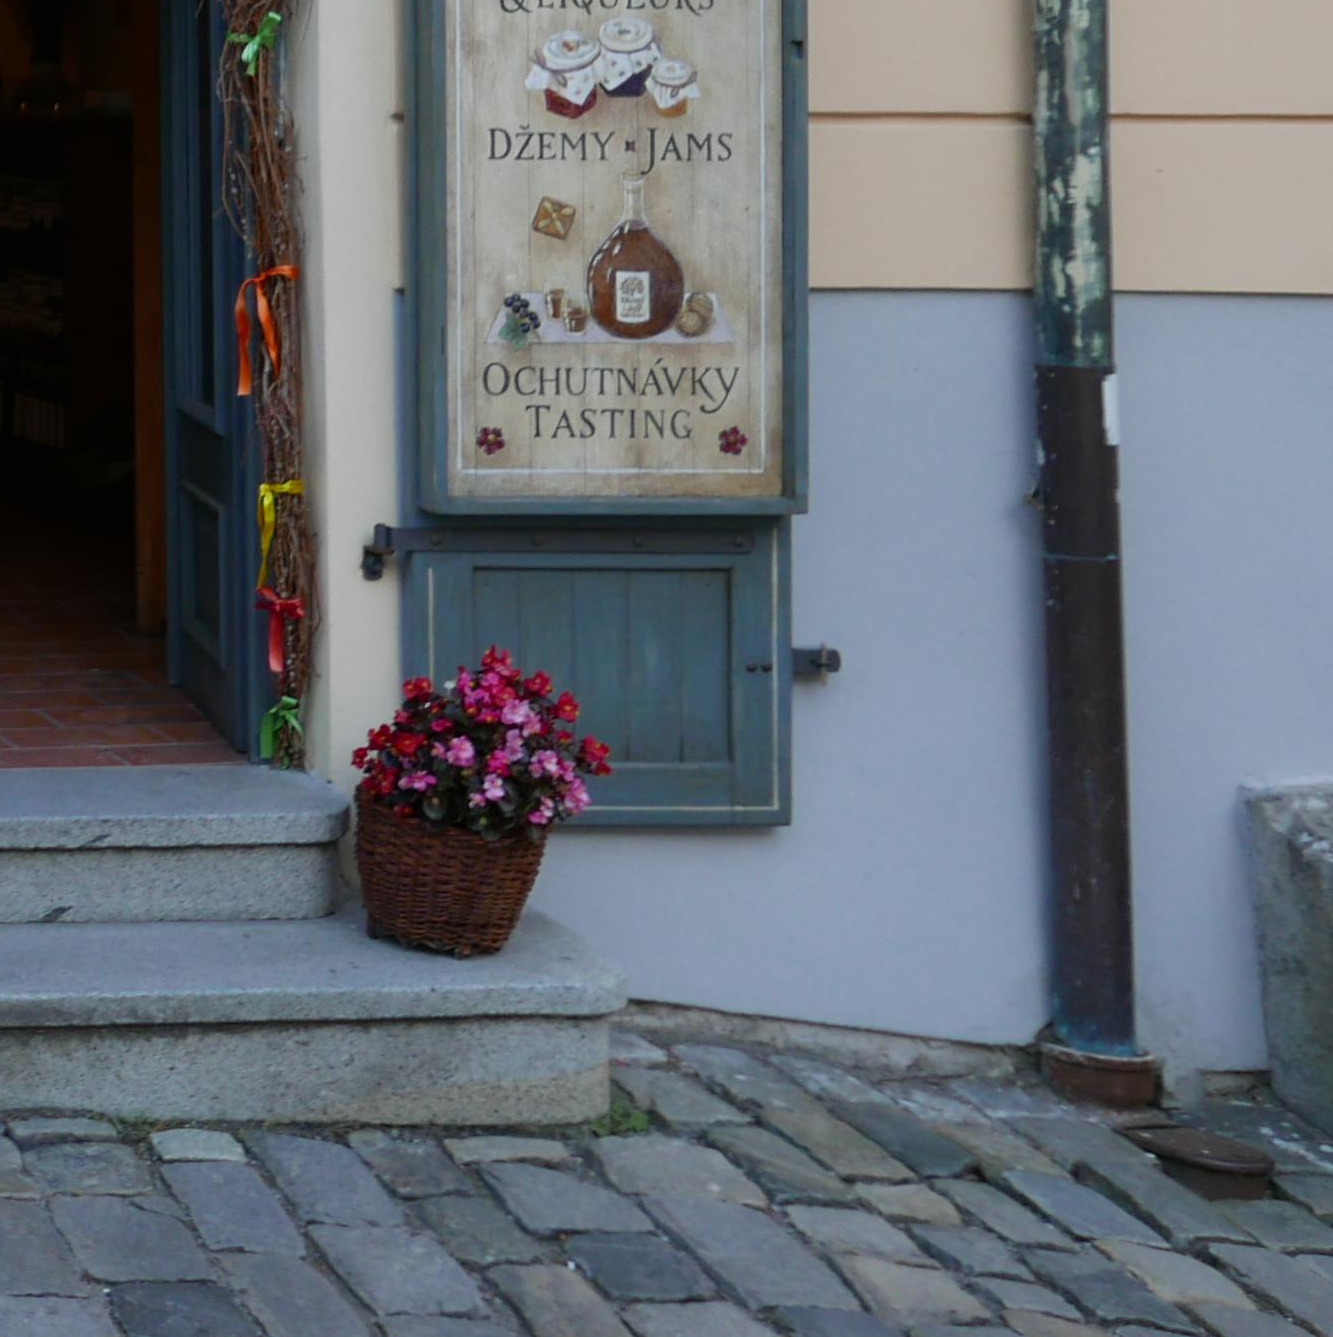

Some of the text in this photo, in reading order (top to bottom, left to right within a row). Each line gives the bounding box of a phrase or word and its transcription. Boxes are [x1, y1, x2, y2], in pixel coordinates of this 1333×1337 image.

[488, 124, 733, 175] DŽEMY JAMS
[482, 358, 741, 414] OCHUTNÁVKY
[525, 404, 694, 439] TASTING
